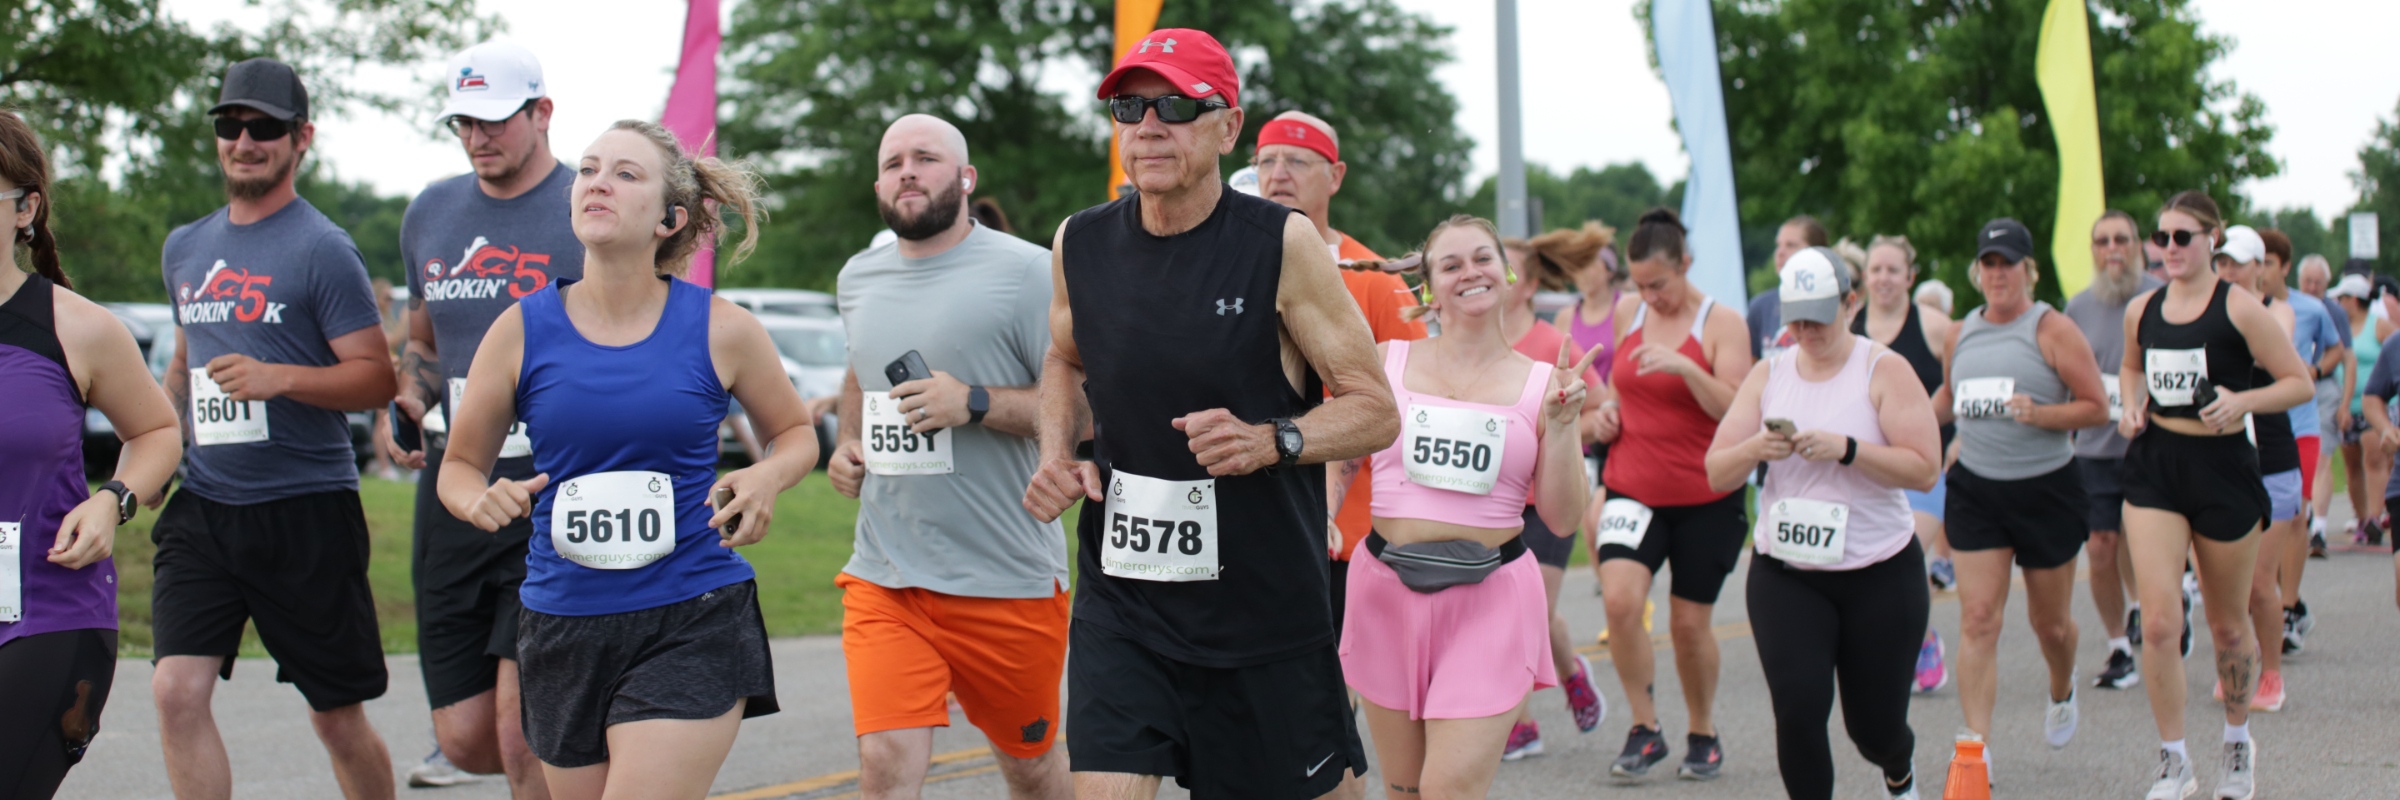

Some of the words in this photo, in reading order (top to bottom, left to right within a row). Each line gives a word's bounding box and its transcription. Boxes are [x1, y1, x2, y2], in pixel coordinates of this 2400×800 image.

[424, 278, 507, 301] SMOKIN'
[1794, 268, 1815, 293] KC
[179, 300, 236, 325] MOKIN'
[2153, 371, 2199, 390] 5627
[1413, 435, 1491, 473] 5550
[566, 508, 661, 544] 5610
[1111, 512, 1203, 556] 5578
[1778, 521, 1836, 549] 5607
[561, 550, 667, 565] timerguys.com
[1106, 557, 1210, 576] timerguys.com
